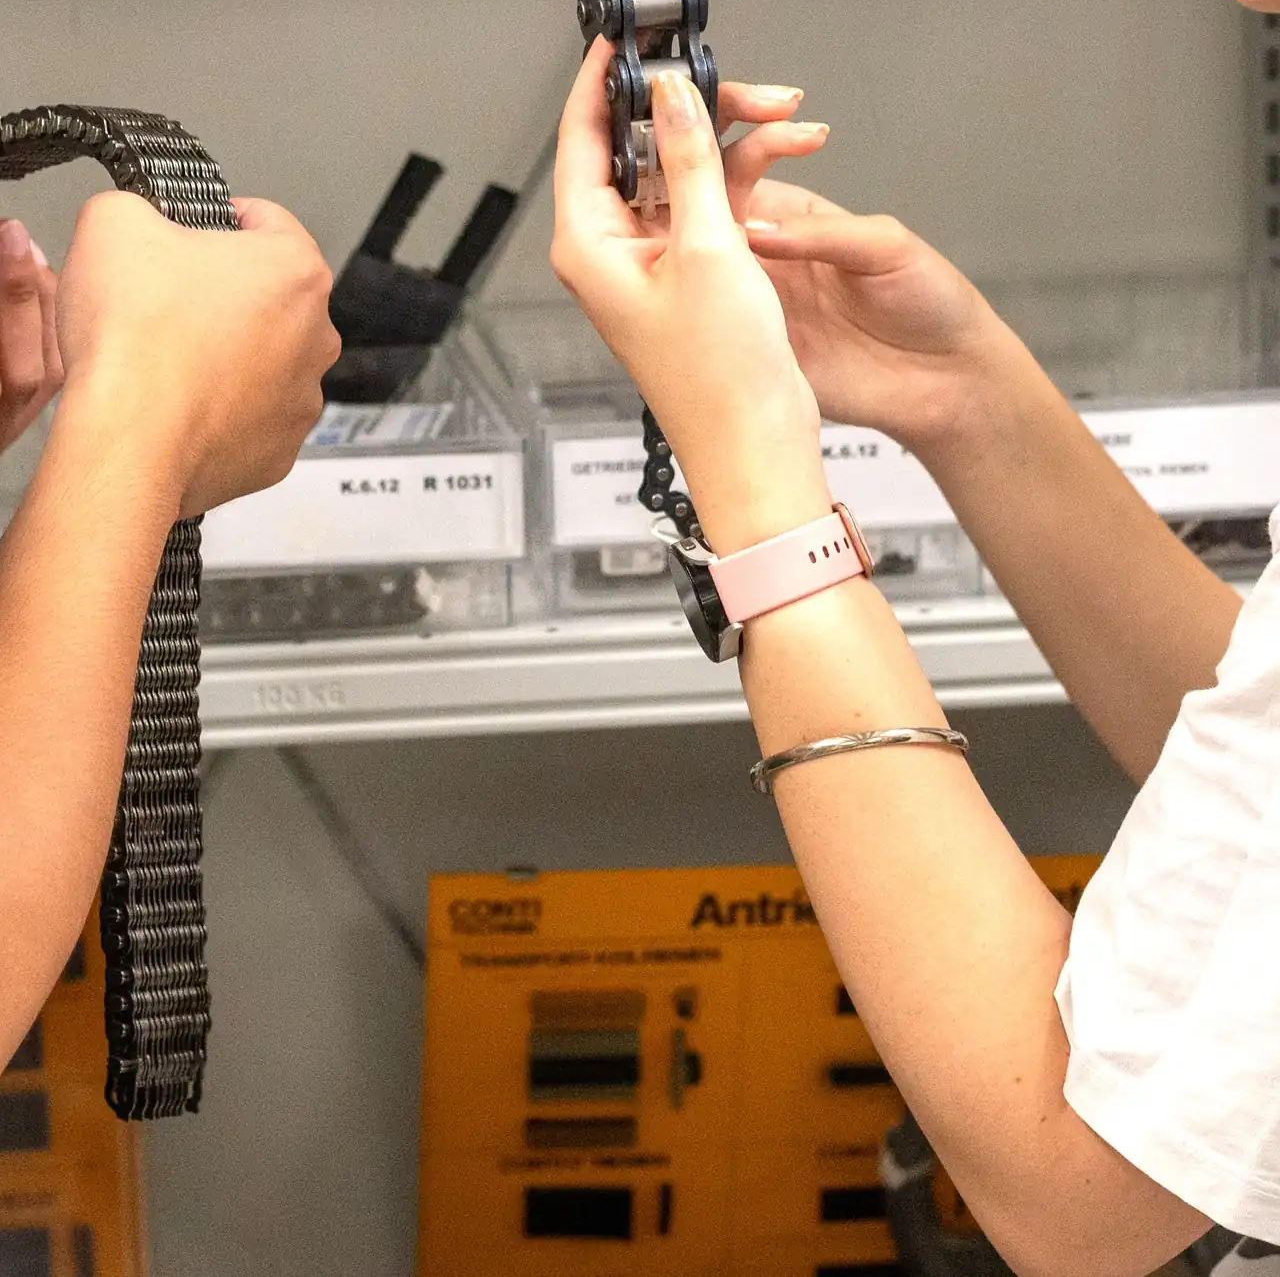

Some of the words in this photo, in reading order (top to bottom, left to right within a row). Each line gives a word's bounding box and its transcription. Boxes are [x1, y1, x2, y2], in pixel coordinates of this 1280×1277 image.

[340, 479, 400, 494] K.6.12
[423, 475, 437, 491] R
[446, 473, 493, 491] 1031
